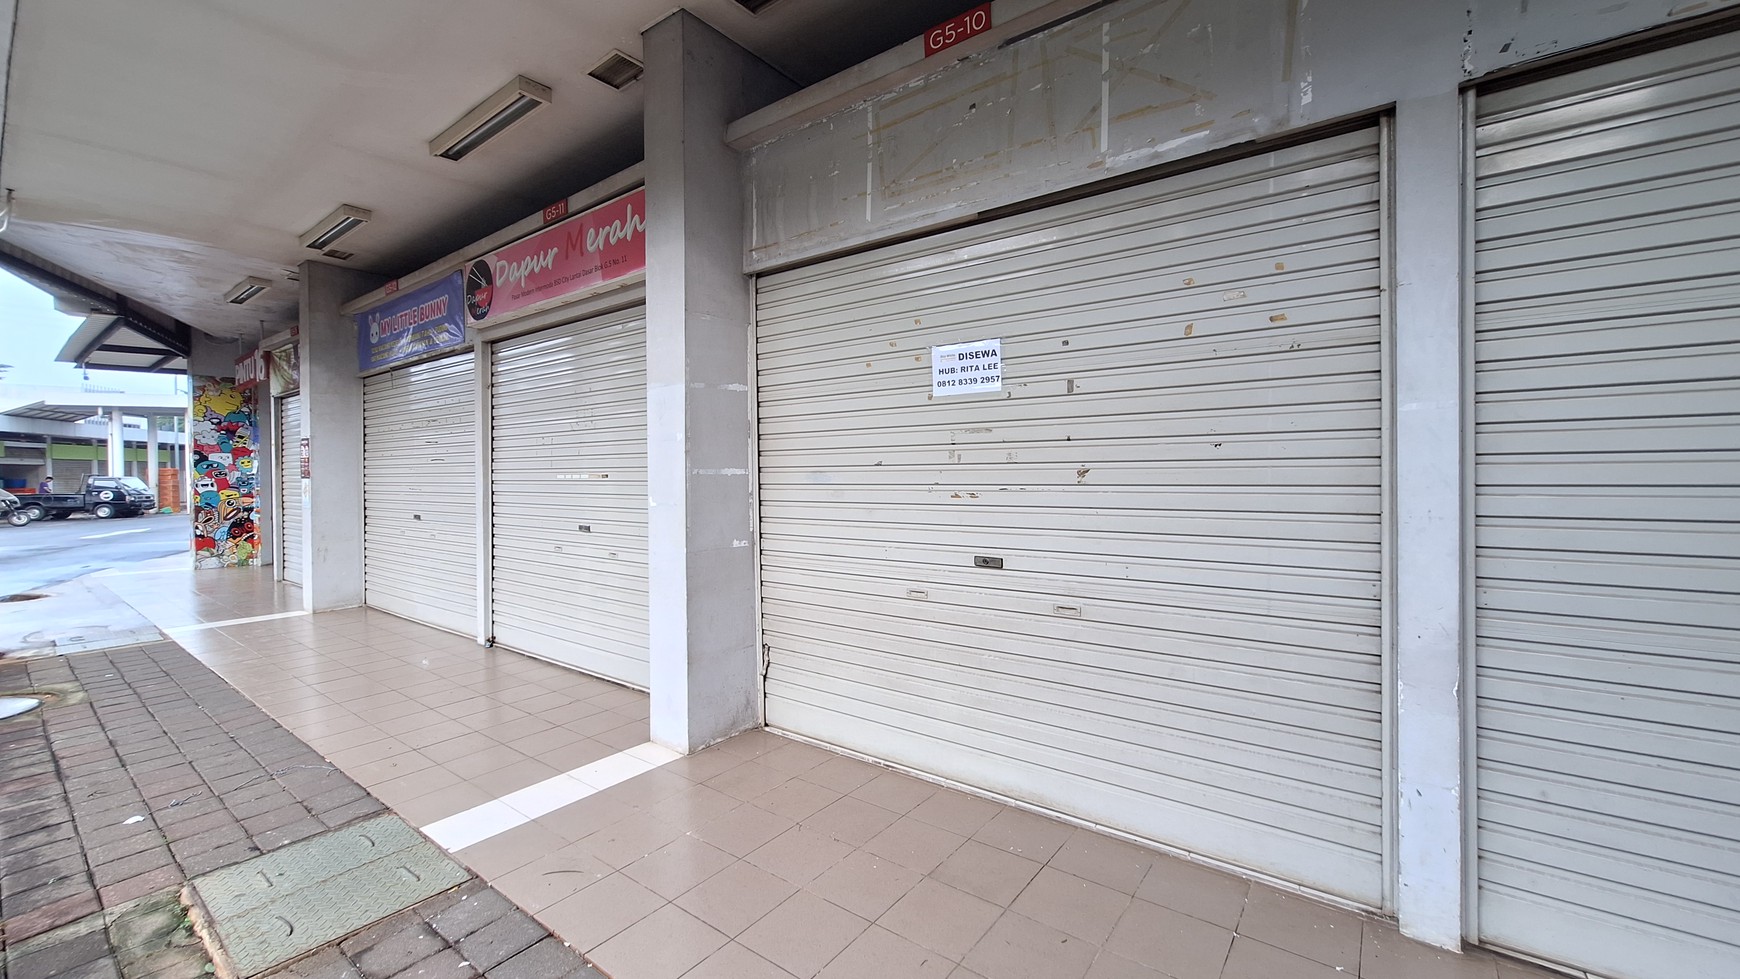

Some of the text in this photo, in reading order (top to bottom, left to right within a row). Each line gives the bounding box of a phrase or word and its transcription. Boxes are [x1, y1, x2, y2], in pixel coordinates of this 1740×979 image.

[929, 10, 986, 49] G5-10
[545, 202, 565, 221] G5-11
[496, 203, 645, 288] Dapur Merah
[521, 287, 535, 298] Modern
[553, 278, 562, 287] BSD
[569, 271, 582, 281] Lantai
[582, 267, 594, 277] Dasar
[594, 263, 603, 272] Blok
[621, 255, 628, 263] 11
[466, 291, 488, 305] Dapur
[380, 317, 391, 338] MY
[391, 307, 418, 334] LITTLE
[418, 294, 449, 324] BUNNY
[958, 349, 998, 361] DISEWA
[234, 355, 255, 386] PINTU
[938, 362, 999, 375] HUB: RITA LEE
[937, 375, 1000, 388] 0812 8339 2957
